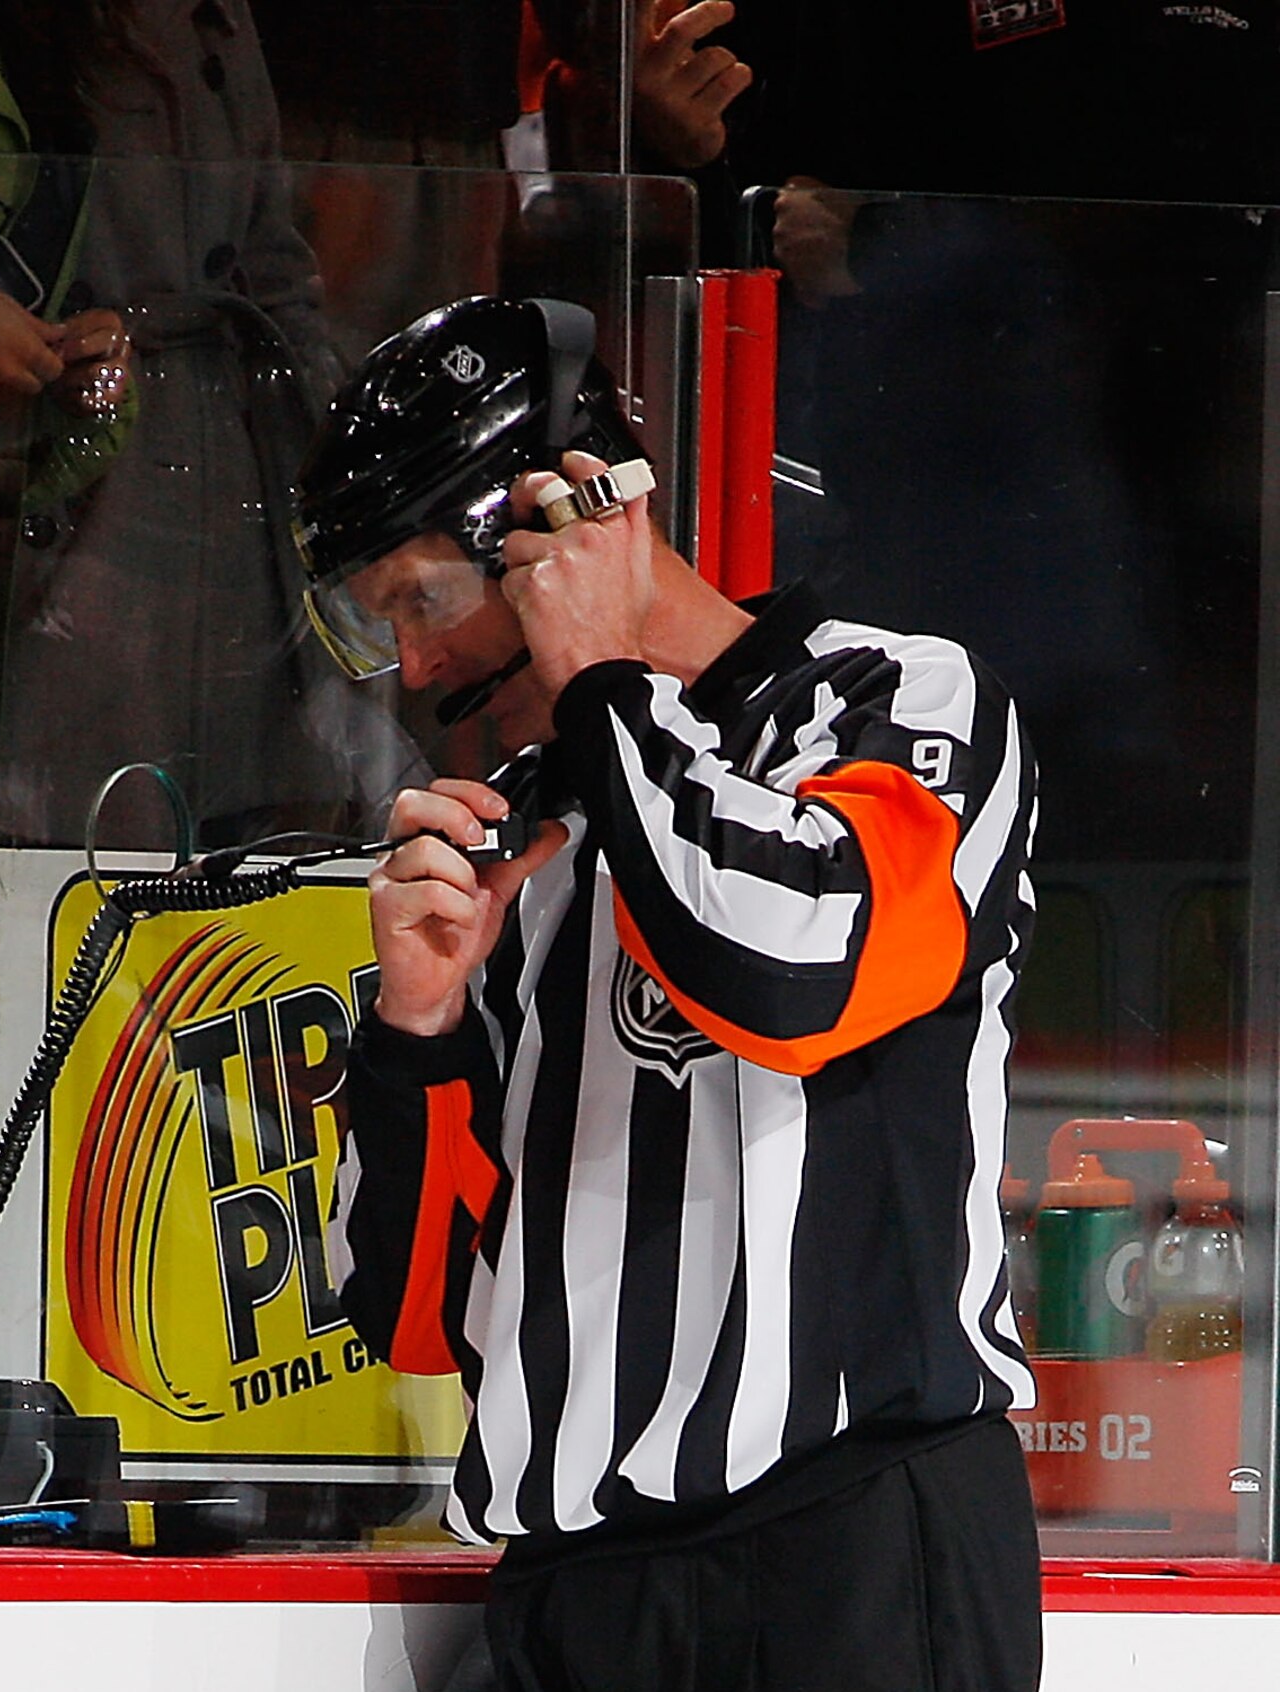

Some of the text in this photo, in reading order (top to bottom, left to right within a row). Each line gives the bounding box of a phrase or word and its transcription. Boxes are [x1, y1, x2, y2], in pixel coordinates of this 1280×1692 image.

[911, 738, 953, 789] 9
[171, 965, 380, 1193] TIR
[230, 1338, 377, 1412] TOTAL C
[1099, 1412, 1152, 1461] 02
